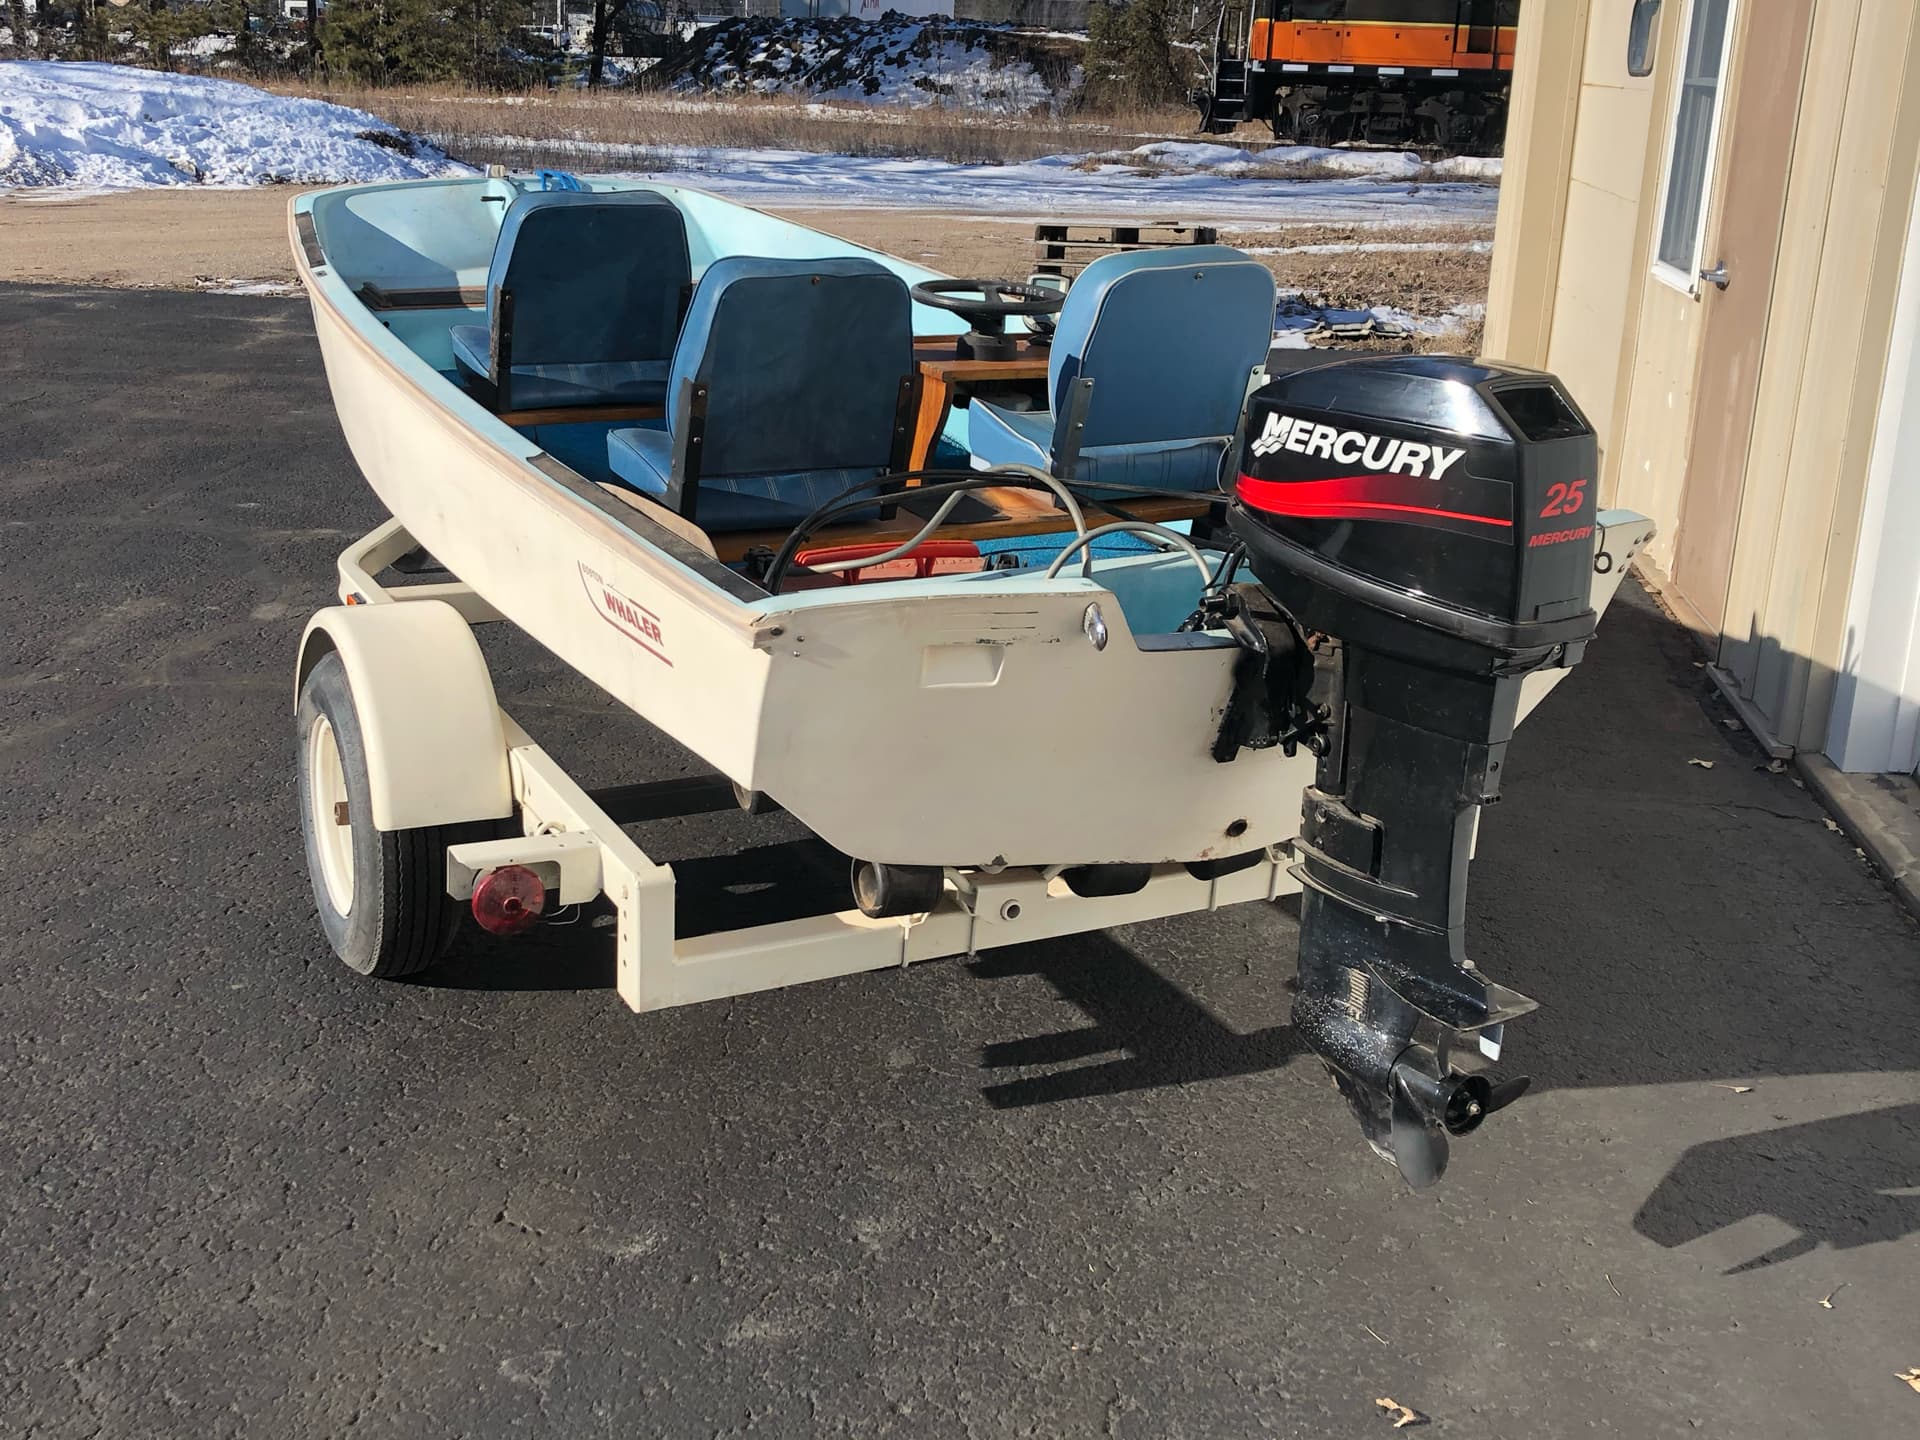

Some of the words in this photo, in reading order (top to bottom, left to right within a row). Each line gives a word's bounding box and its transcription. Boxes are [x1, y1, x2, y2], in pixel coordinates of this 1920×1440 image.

[1251, 412, 1467, 480] MERCURY
[1540, 479, 1587, 518] 25
[1528, 527, 1594, 547] MERCURY
[603, 589, 664, 647] WHALER
